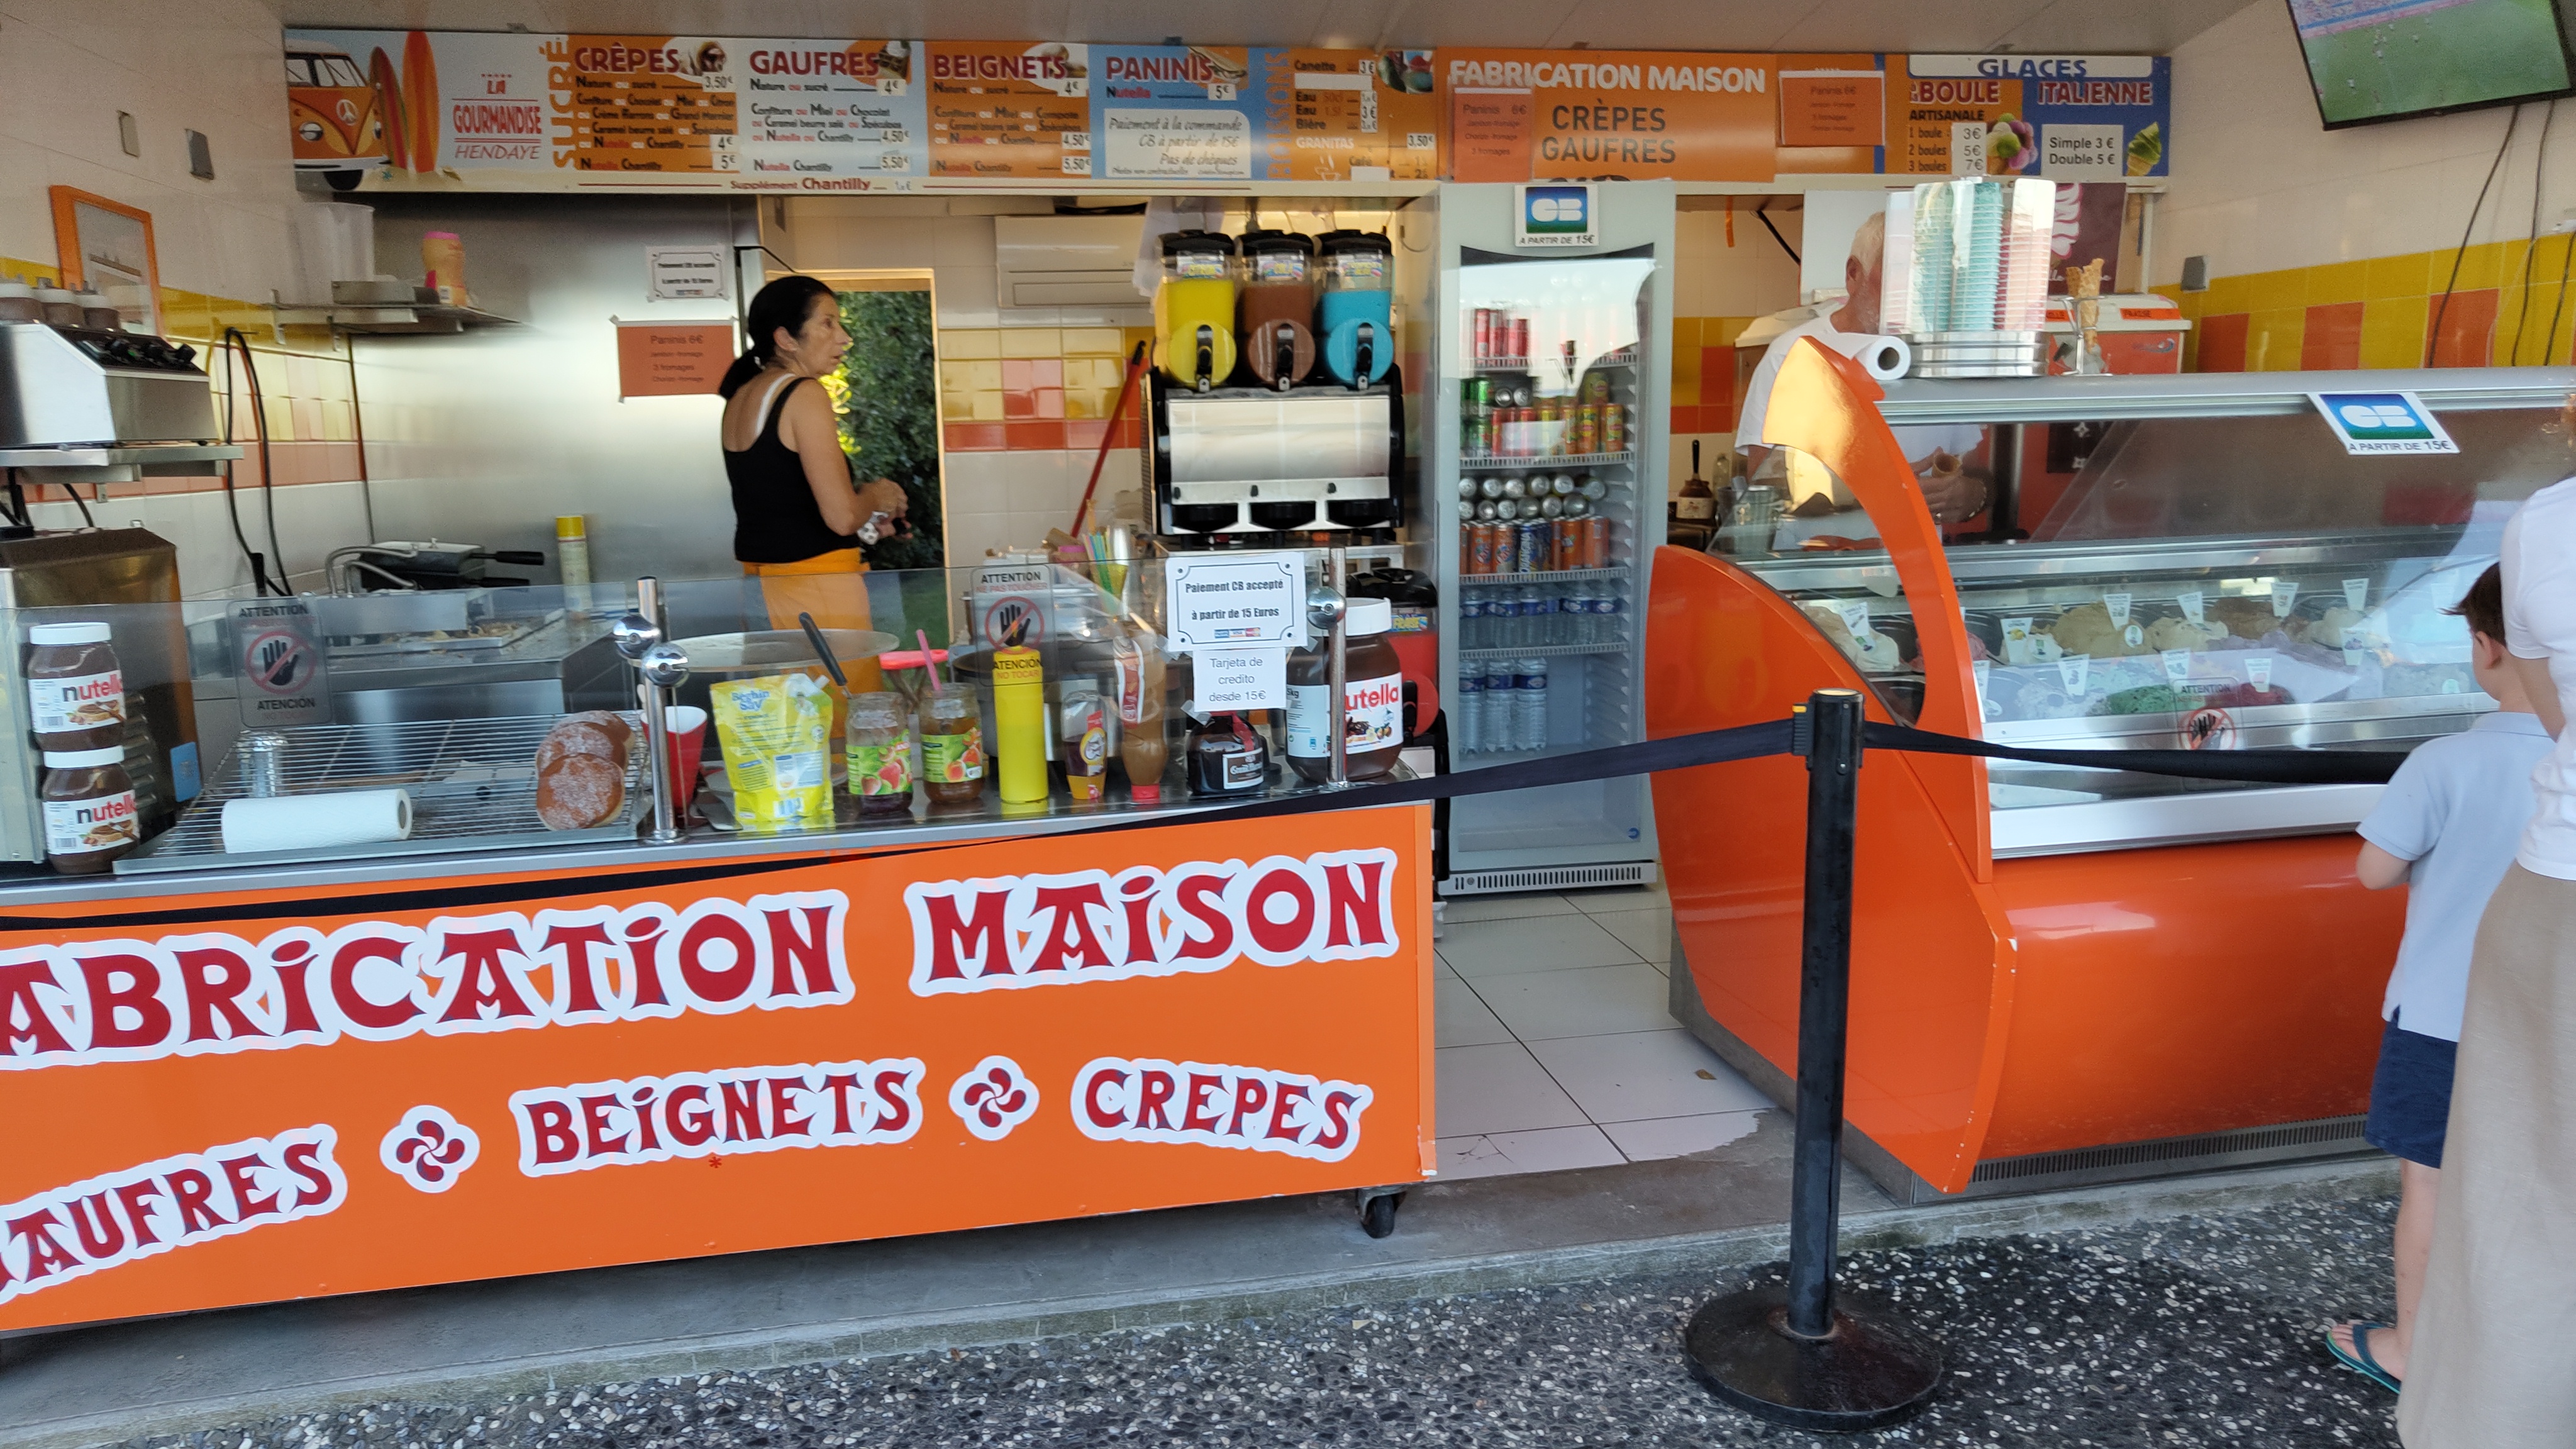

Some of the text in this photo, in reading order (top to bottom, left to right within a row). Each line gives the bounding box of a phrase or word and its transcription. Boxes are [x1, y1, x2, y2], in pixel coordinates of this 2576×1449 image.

[574, 42, 680, 74] CRÊPES
[749, 50, 879, 76] GAUFRES
[933, 54, 1067, 79] BEIGNETS
[1106, 56, 1214, 81] PANINIS
[1977, 58, 2087, 79] GLACES
[1450, 60, 1765, 94] FABRICATION MAISON
[1296, 91, 1317, 102] Eau
[1919, 80, 2001, 104] BOULE
[2038, 81, 2152, 104] ITALIENNE
[1264, 52, 1291, 179] BOISSONS
[1296, 104, 1317, 115] Eau
[1909, 109, 1984, 121] ARTISANALE
[452, 104, 543, 135] GOURMANDISE
[1963, 127, 1982, 140] 3€
[1296, 137, 1355, 150] GRANITAS
[1541, 136, 1675, 164] GAUFRES
[2049, 136, 2114, 151] Simple 3 €
[454, 145, 540, 160] HENDAYE
[1963, 145, 1982, 157] 5€
[721, 155, 736, 169] 5€
[1965, 158, 1984, 171] 7€
[2049, 153, 2116, 165] Double 5 €
[802, 177, 870, 191] Chantilly
[1527, 236, 1558, 245] PARTIR
[1560, 236, 1573, 244] DE
[1575, 234, 1596, 244] 15€
[2358, 442, 2401, 451] PARTIR
[2404, 442, 2421, 450] DE
[2424, 440, 2452, 451] 15€
[981, 570, 1041, 584] ATTENTION
[1185, 578, 1284, 594] Paiement CB accepté
[238, 604, 309, 618] ATTENTION
[1191, 607, 1280, 621] à partir de 15 Euros
[1209, 657, 1263, 670] Tarjeta de
[1218, 674, 1255, 685] credito
[1209, 690, 1267, 702] desde 15€
[1084, 1067, 1362, 1150] CREPES
